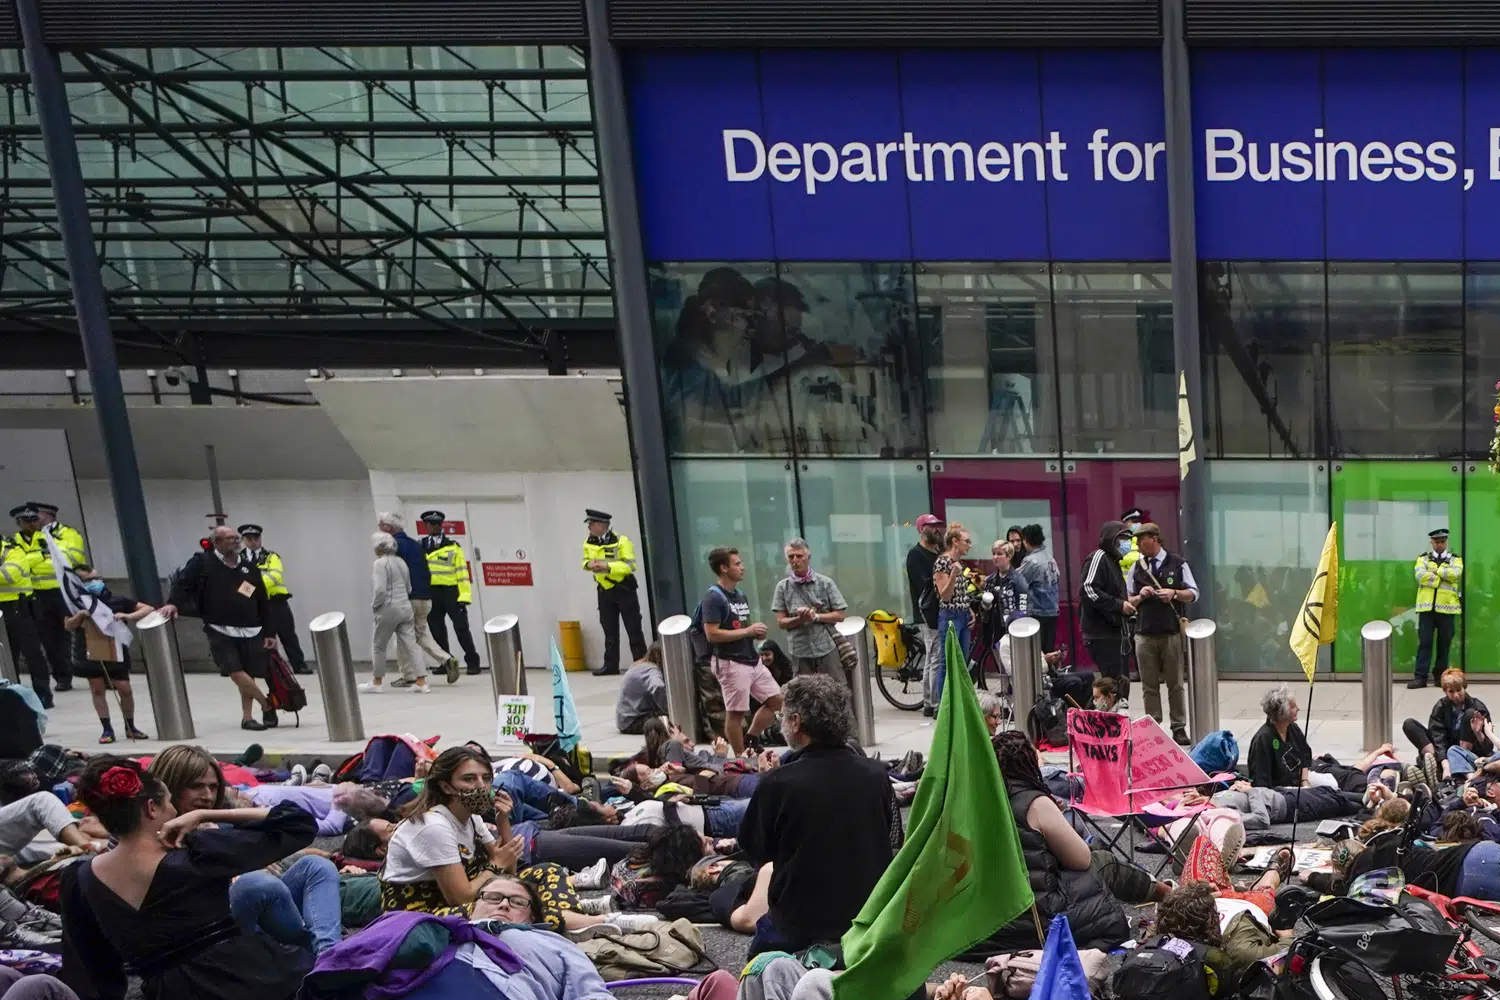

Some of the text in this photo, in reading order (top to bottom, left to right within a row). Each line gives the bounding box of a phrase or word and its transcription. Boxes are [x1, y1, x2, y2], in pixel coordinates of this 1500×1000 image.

[723, 128, 1069, 195] Department
[1088, 128, 1166, 182] for
[1206, 128, 1475, 191] Business,
[507, 704, 527, 714] LIFE
[506, 715, 526, 725] FOR
